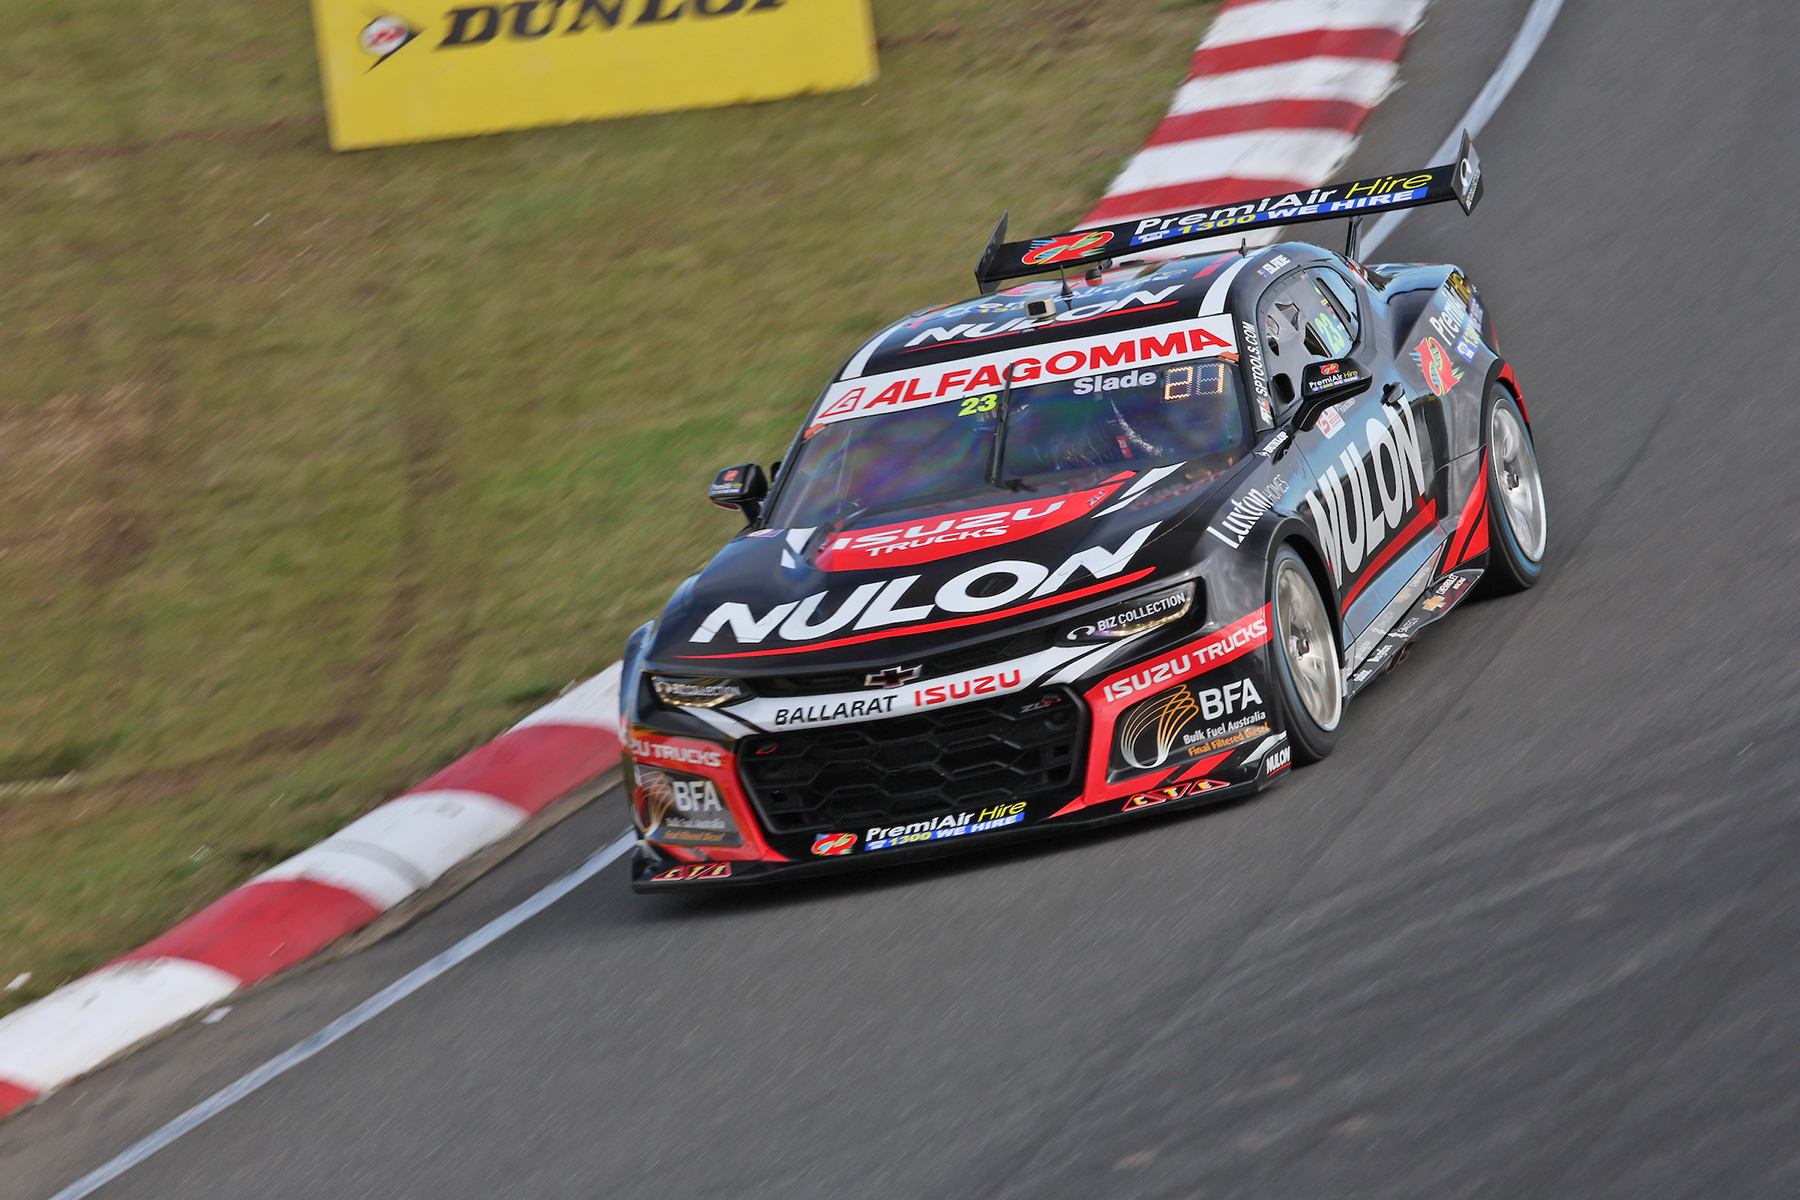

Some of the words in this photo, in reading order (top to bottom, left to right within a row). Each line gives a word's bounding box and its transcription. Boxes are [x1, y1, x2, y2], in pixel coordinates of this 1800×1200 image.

[1135, 187, 1337, 235] PremiAir
[1345, 174, 1433, 199] Hire
[1178, 214, 1257, 234] 1300
[1267, 203, 1318, 220] WE
[1330, 190, 1414, 211] HIRE
[1262, 254, 1291, 275] SLADE
[904, 284, 1185, 348] NULON
[1315, 313, 1345, 354] 23
[863, 328, 1232, 410] ALFAGOMMA
[1242, 321, 1268, 397] SPTOOLS.COM
[1073, 370, 1157, 396] Slade
[1309, 373, 1343, 389] PremiAir
[1343, 370, 1358, 379] Hire
[958, 394, 998, 417] 23
[1263, 431, 1289, 454] DUNLOP
[1206, 488, 1275, 549] Luxton
[1262, 474, 1290, 504] HOMES
[1304, 400, 1426, 590] NULON
[831, 500, 1066, 550] ISUZU
[865, 525, 1010, 557] TRUCKS
[689, 520, 1162, 643] NULON
[1097, 615, 1118, 632] BIZ
[1118, 592, 1186, 624] COLLECTION
[1103, 654, 1192, 702] ISUZU
[1192, 618, 1268, 666] TRUCKS
[775, 694, 898, 726] BALLARAT
[914, 669, 1021, 707] ISUZU
[1199, 677, 1263, 720] BFA
[1183, 732, 1206, 744] Bulk
[1206, 723, 1228, 738] Fuel
[1227, 710, 1266, 732] Australia
[1188, 742, 1212, 757] Final
[1210, 729, 1245, 750] Filtered
[1243, 722, 1270, 739] Diesel
[650, 743, 721, 767] TRUCKS
[1266, 746, 1290, 774] NULON
[673, 780, 722, 811] BFA
[866, 811, 974, 841] PremiAir
[977, 801, 1027, 822] Hire
[888, 832, 932, 846] 1300
[937, 827, 965, 838] WE
[970, 815, 1017, 832] HIRE
